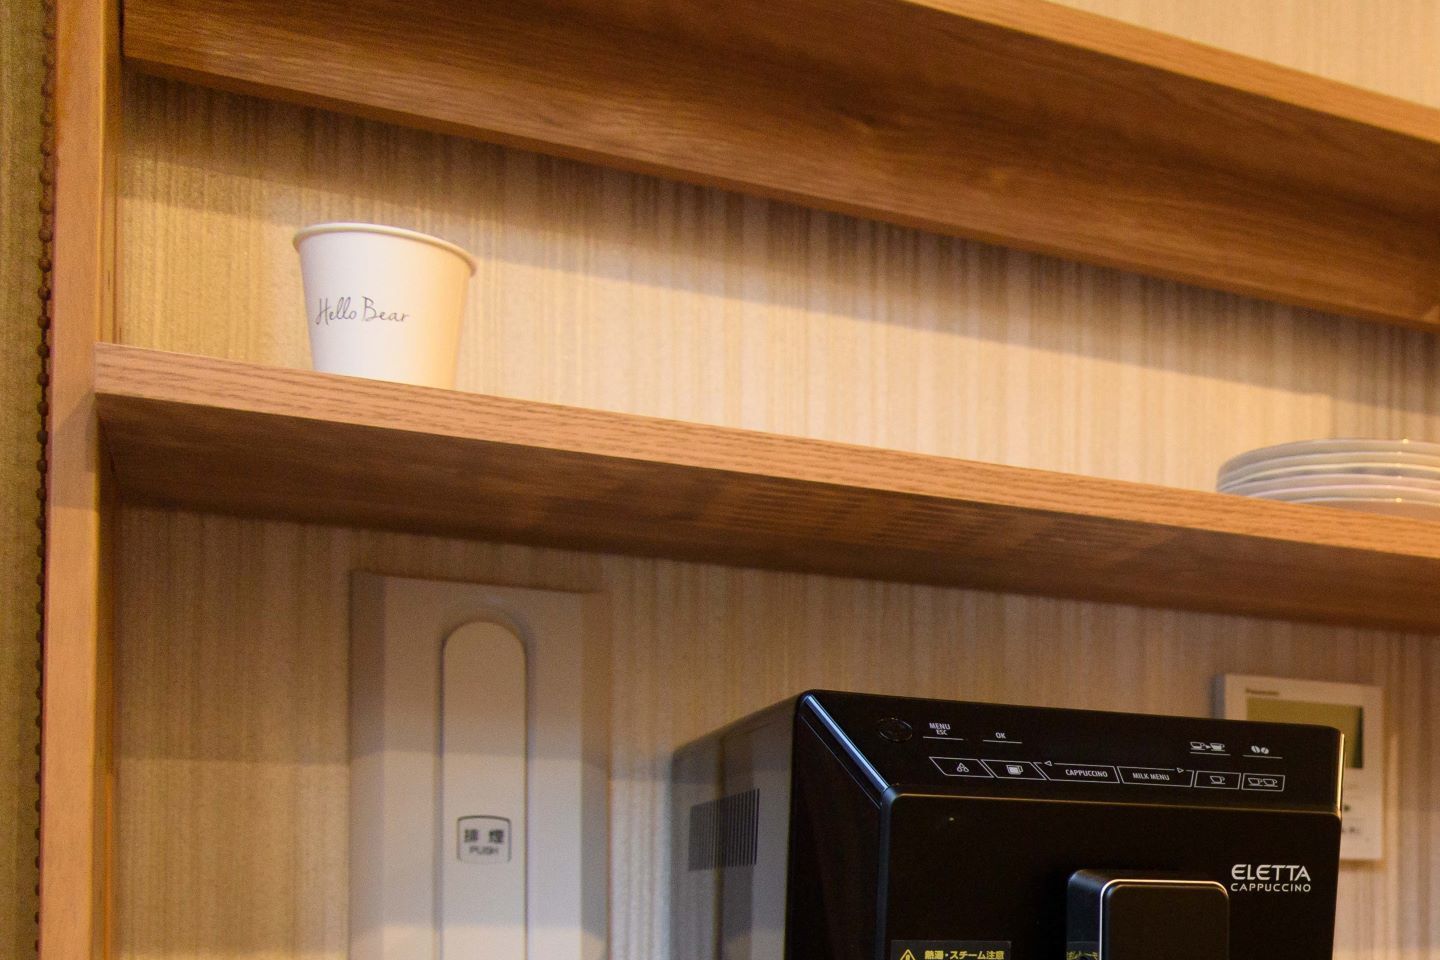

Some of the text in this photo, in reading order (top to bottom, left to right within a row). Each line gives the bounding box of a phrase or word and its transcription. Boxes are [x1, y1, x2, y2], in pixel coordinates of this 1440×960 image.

[314, 295, 410, 325] Hello Bear
[929, 722, 951, 731] MENU
[1065, 769, 1109, 778] CAPPUCCINO
[1132, 772, 1170, 781] MILK MENU
[1231, 863, 1311, 882] ELETTA
[1230, 882, 1311, 893] CAPPUCCINO
